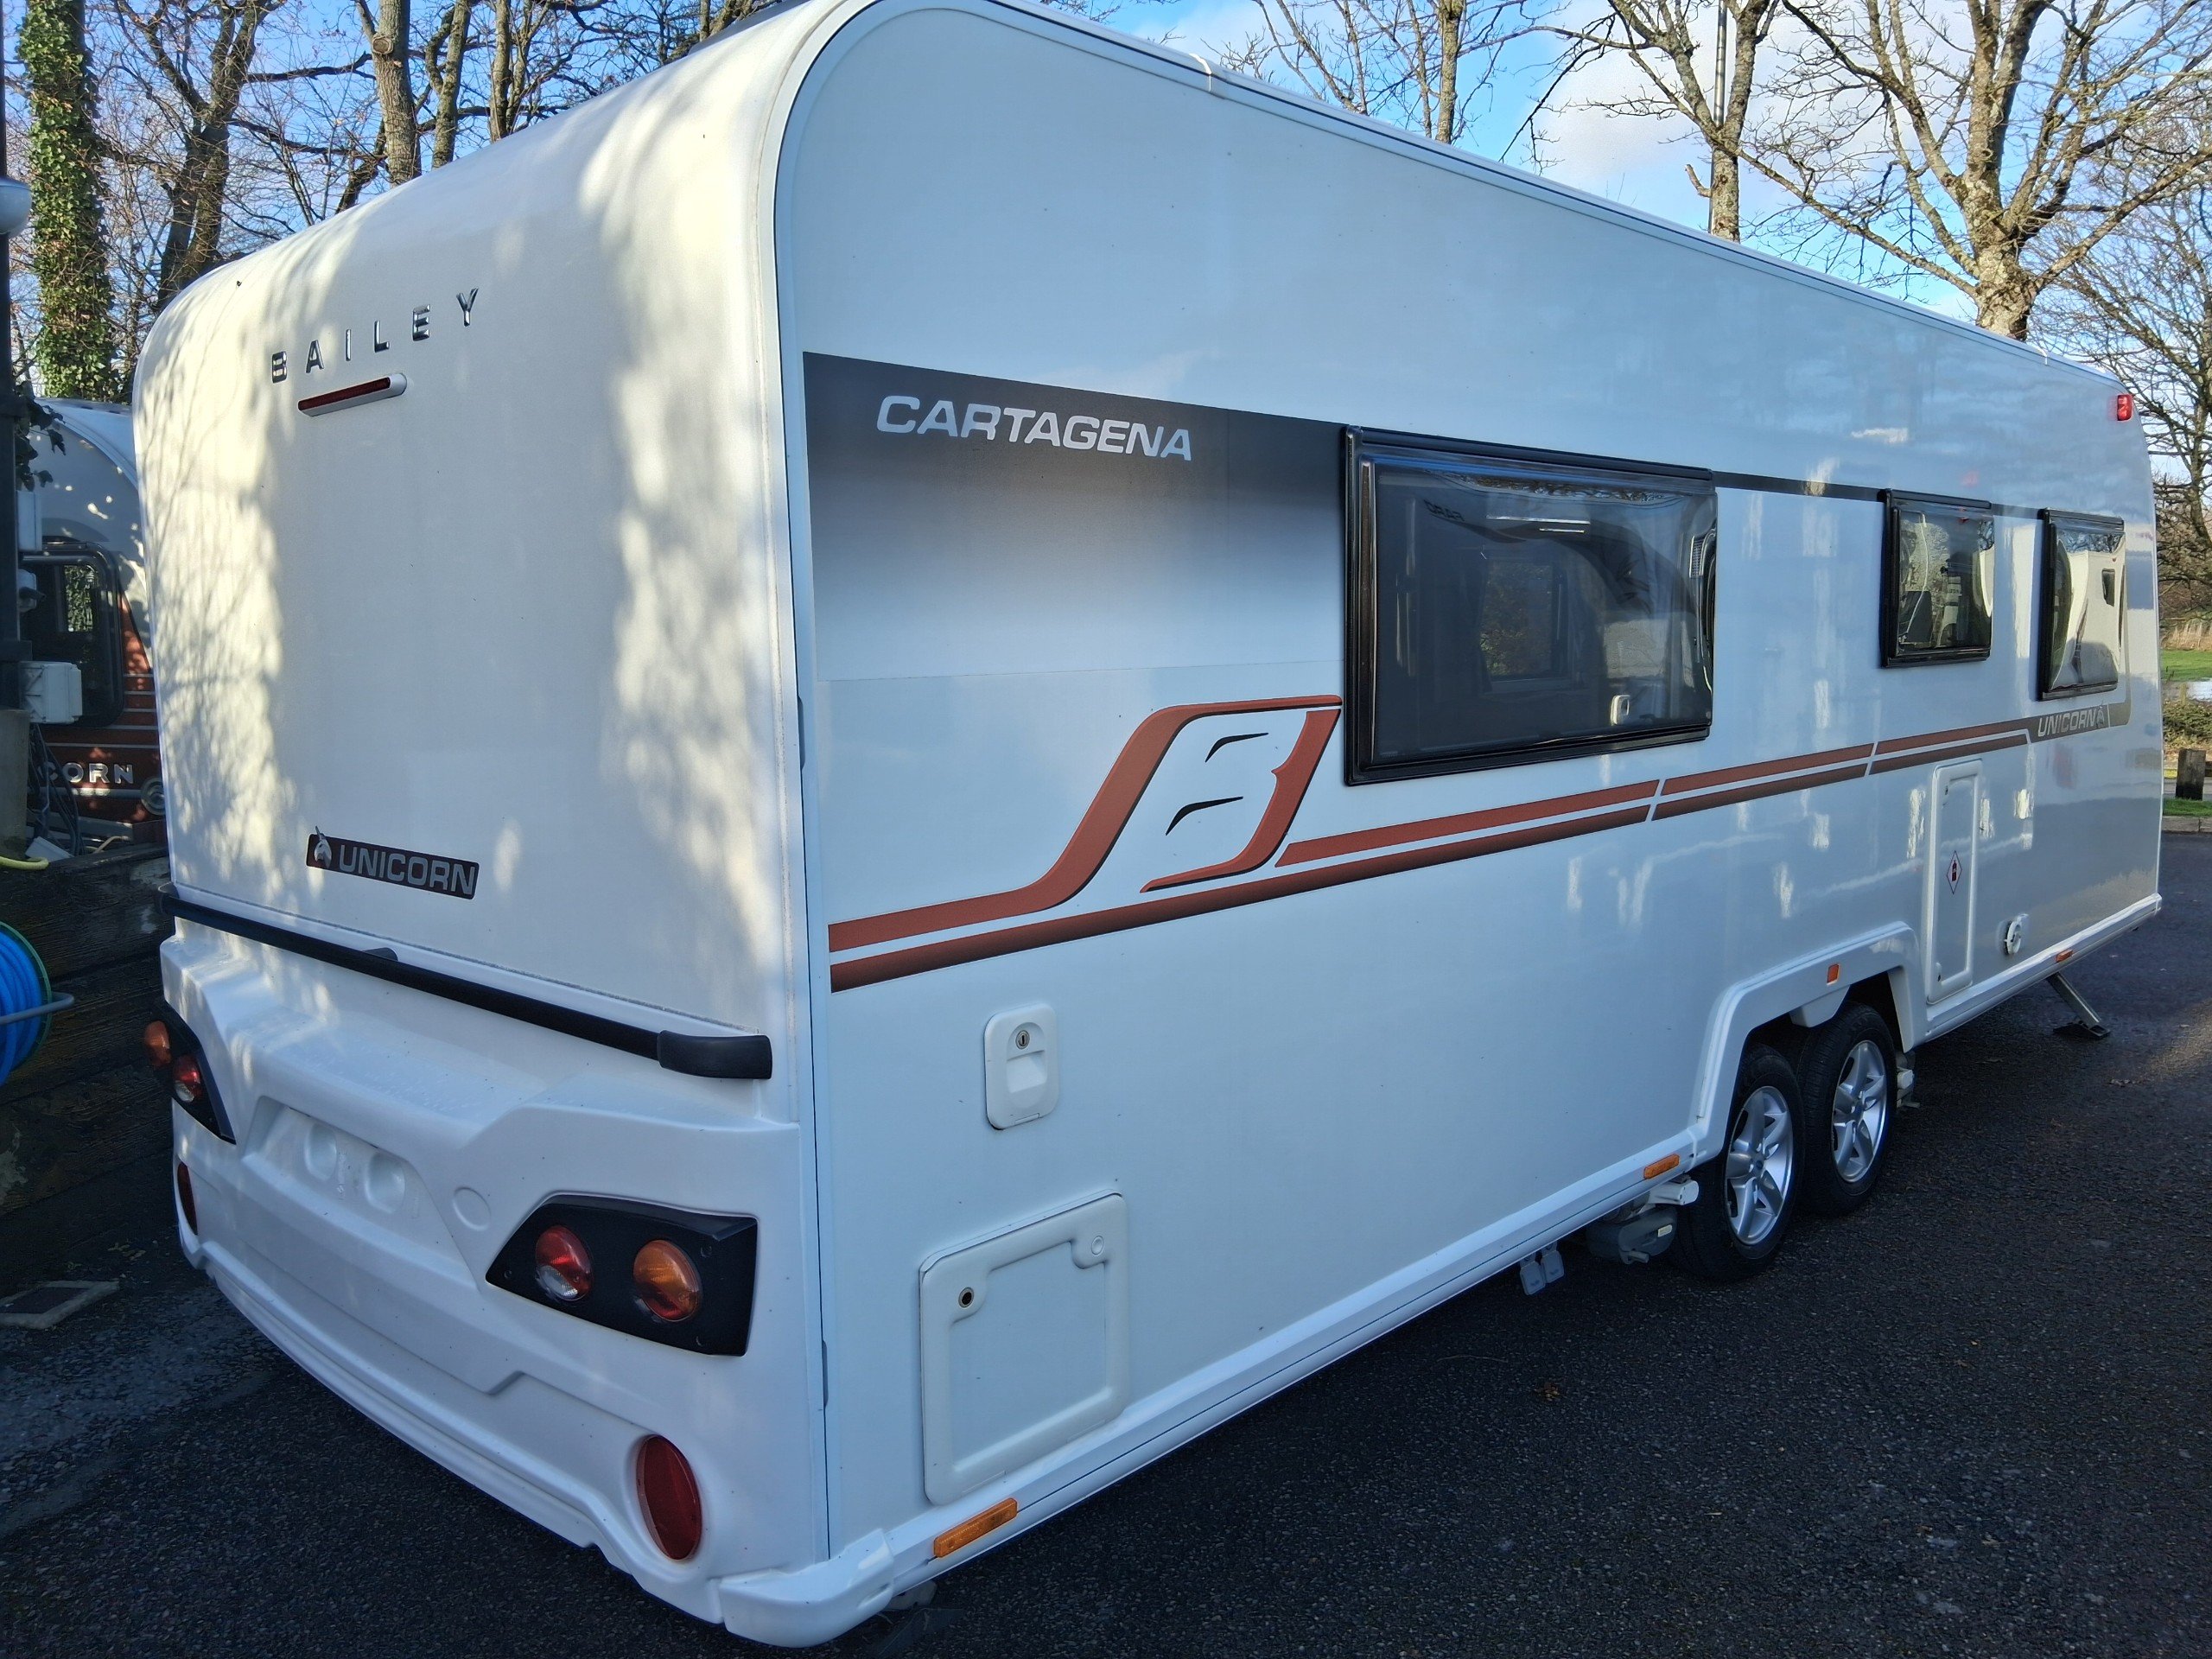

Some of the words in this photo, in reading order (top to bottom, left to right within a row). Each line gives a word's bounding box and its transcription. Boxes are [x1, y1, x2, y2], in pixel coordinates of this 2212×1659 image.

[271, 287, 479, 384] BAILEY
[876, 395, 1192, 461] CARTAGENA
[2037, 709, 2097, 737] UNICORN
[339, 844, 475, 895] UNICORN
